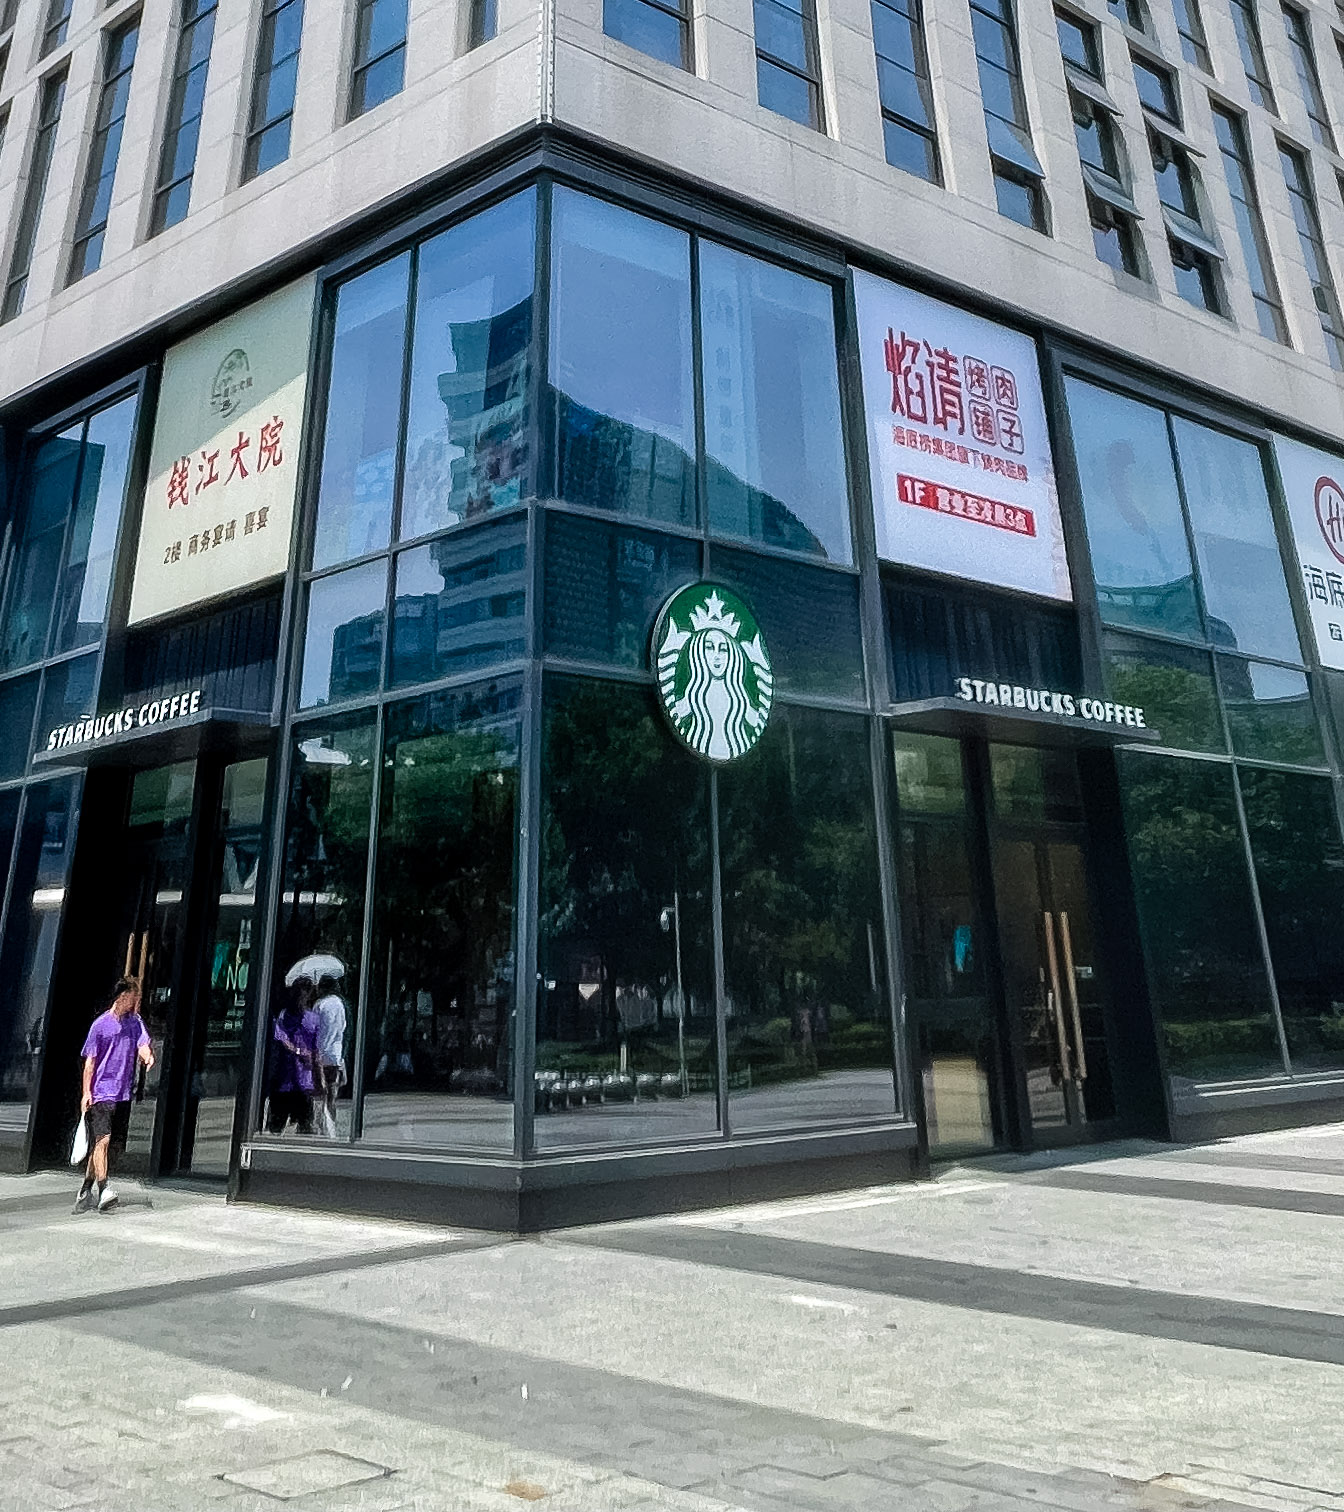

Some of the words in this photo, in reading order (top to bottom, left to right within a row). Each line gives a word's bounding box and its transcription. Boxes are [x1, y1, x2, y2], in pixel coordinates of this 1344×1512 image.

[167, 415, 284, 509] 钱江大院
[904, 479, 926, 504] 1F
[47, 708, 134, 751] STARBUCKS
[138, 690, 202, 727] COFFEE
[956, 678, 1077, 717] STARBUCKS
[1079, 698, 1148, 729] COFFEE
